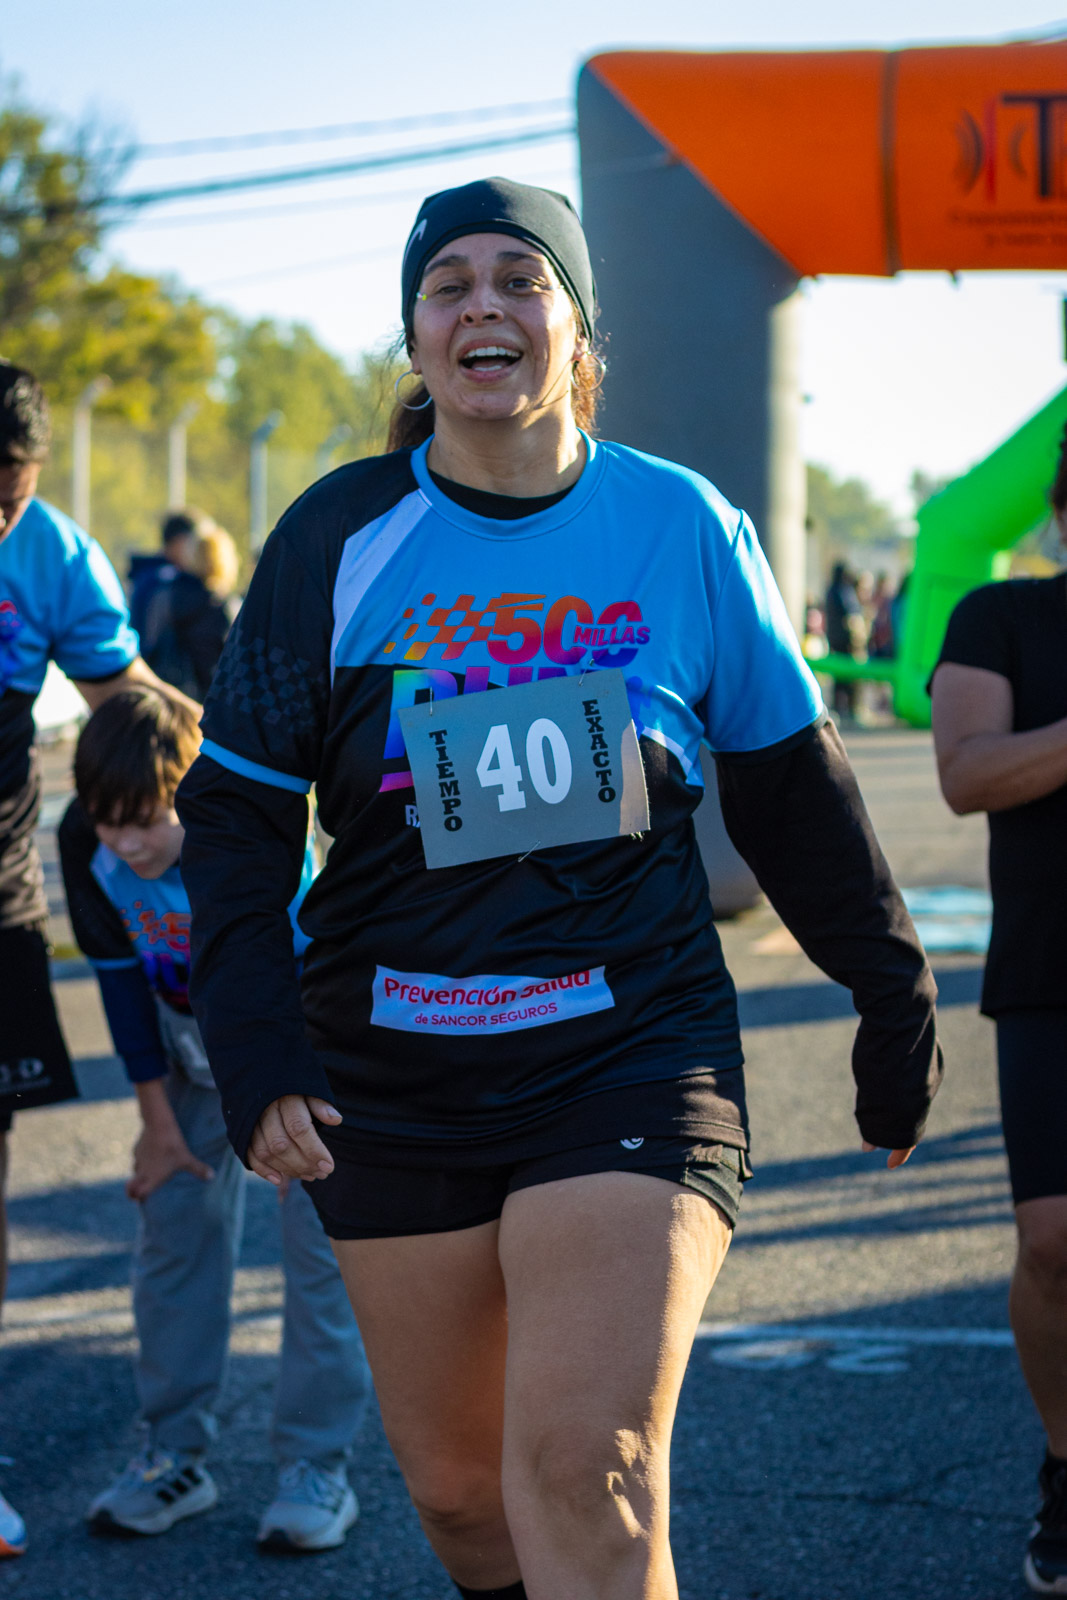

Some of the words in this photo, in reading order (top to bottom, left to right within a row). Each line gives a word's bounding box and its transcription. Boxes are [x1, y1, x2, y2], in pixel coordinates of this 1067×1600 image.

[573, 625, 651, 647] MILLAS
[428, 729, 463, 832] TIEMPO
[475, 717, 573, 813] 40
[582, 699, 617, 804] EXACTO
[384, 977, 517, 1006] Prevención
[414, 1012, 429, 1025] de
[431, 1013, 486, 1027] SANCOR
[489, 1001, 558, 1025] SEGUROS
